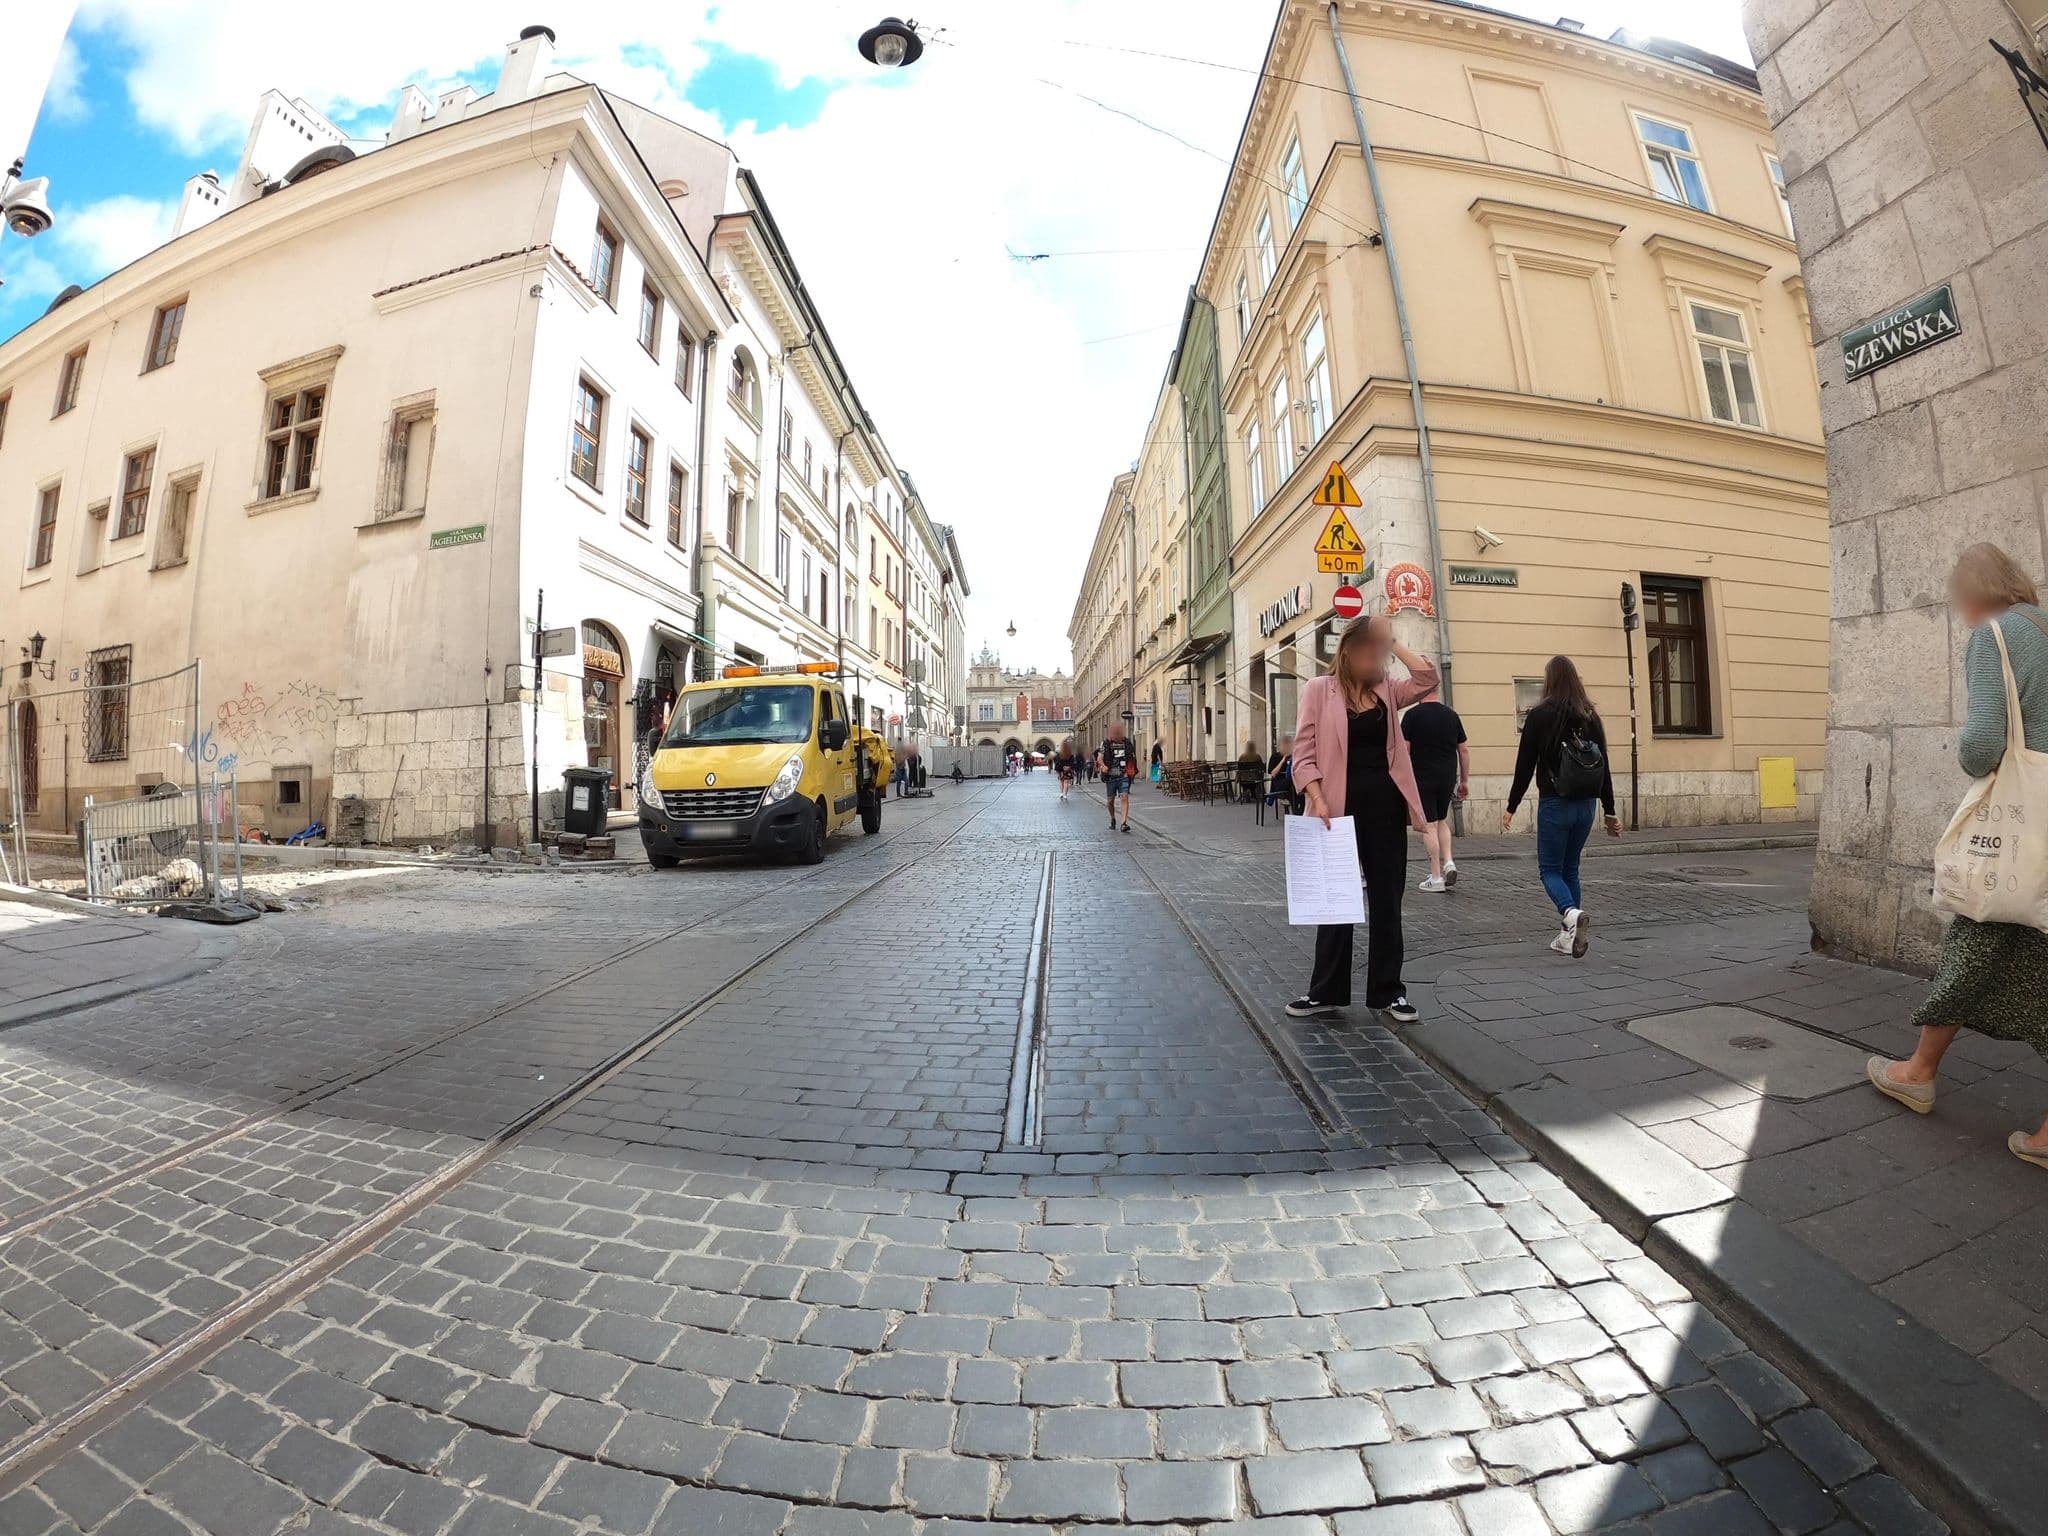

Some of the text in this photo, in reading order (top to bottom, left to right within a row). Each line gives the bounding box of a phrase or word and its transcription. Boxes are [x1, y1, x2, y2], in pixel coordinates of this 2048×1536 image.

[1844, 308, 1956, 374] SZEWSKA
[1872, 309, 1914, 335] ULICA
[1257, 584, 1300, 638] LAJKONIK
[1969, 834, 2002, 849] #EKO
